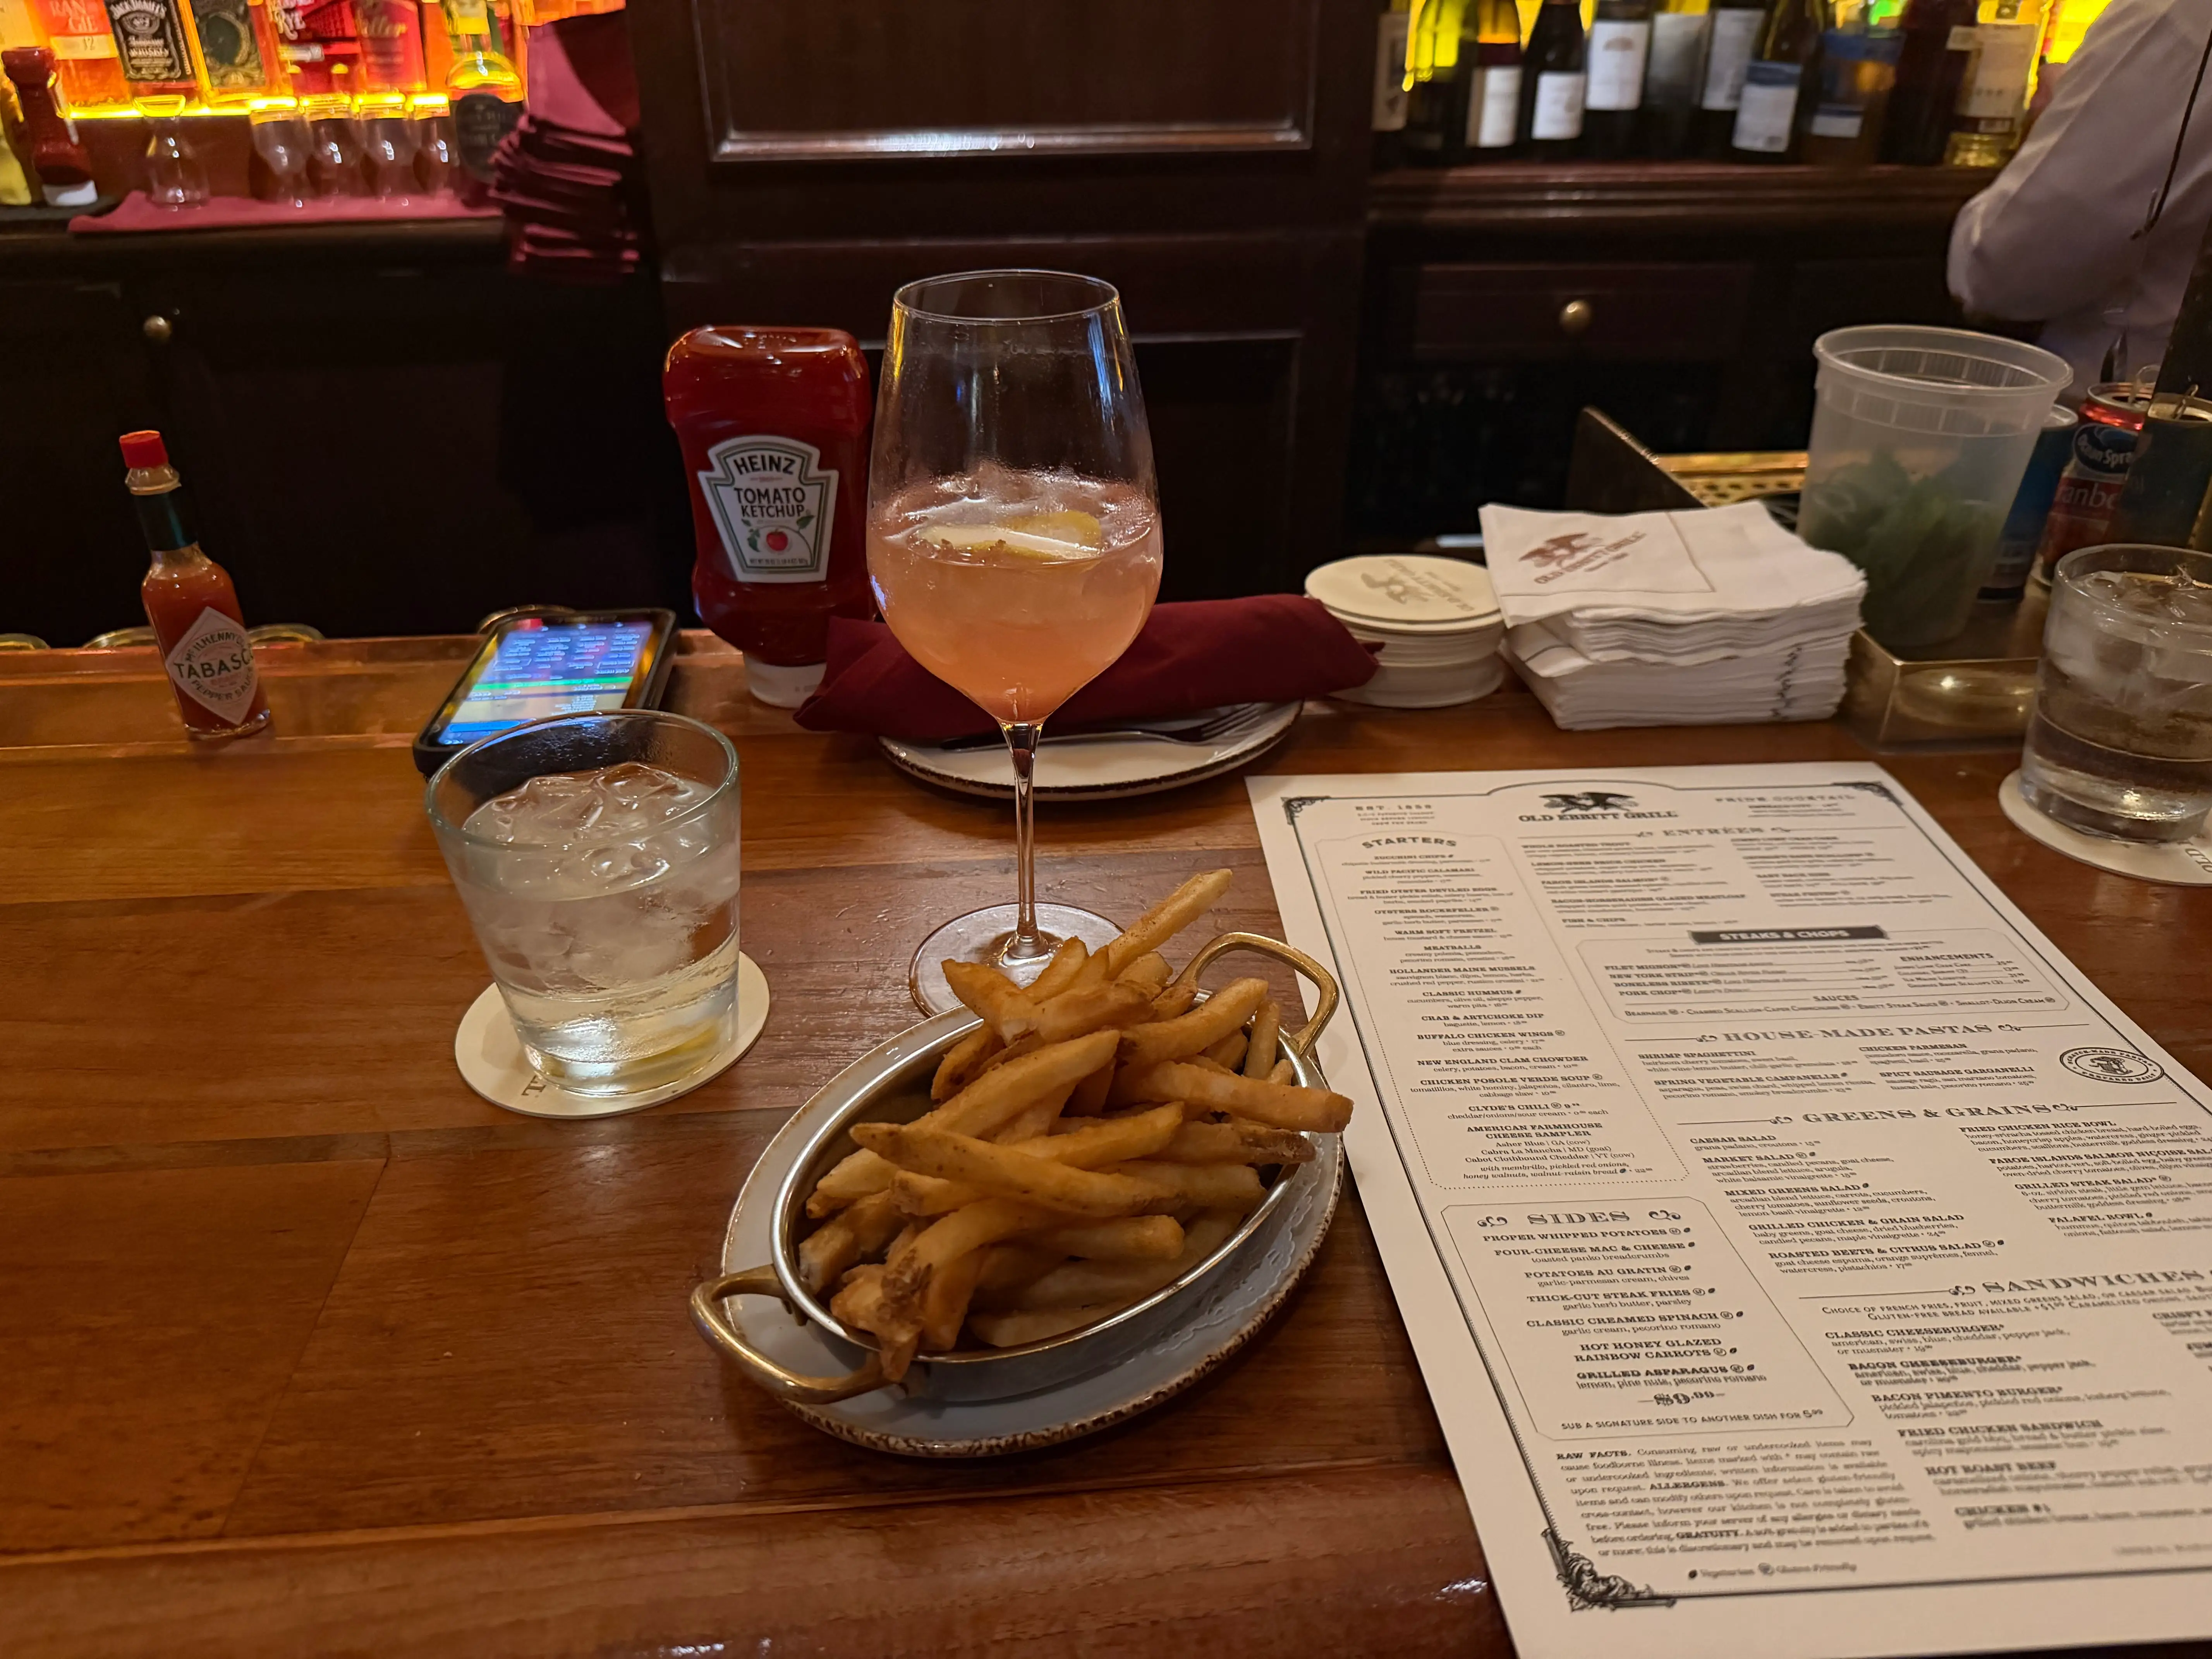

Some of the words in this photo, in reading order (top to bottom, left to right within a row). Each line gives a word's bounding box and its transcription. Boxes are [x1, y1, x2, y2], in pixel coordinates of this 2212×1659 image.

[733, 454, 796, 475] HEINZ
[733, 487, 805, 504] TOMATO
[741, 504, 805, 518] KETCHUP
[191, 680, 233, 700] PEPPER
[1362, 836, 1457, 849] STARTERS
[1720, 932, 1781, 941] STEAKS
[1796, 929, 1850, 939] CHOPS
[1899, 953, 1994, 962] ENHANCEMENTS
[1722, 1028, 1894, 1041] HOUSE-MADE
[1896, 1025, 1992, 1036] PASTAS
[1803, 1110, 1916, 1122] GREENS
[1946, 1104, 2051, 1117] GRAINS
[1527, 1211, 1630, 1224] SIDES
[1807, 1219, 1865, 1228] CHICKEN
[1494, 1247, 1587, 1255] FOUR-CHEESE
[1982, 1270, 2205, 1292] SANDWICHES
[1527, 1293, 1599, 1302] THICK-CUT
[1527, 1319, 1584, 1327] CLASSIC
[1587, 1316, 1656, 1324] CREAMED
[1659, 1313, 1719, 1321] SPINACH
[1826, 1330, 1884, 1338] CLASSIC
[1612, 1341, 1662, 1349] HONEY
[1666, 1339, 1721, 1347] GLAZED
[1574, 1352, 1640, 1362] RAINBOW
[1645, 1349, 1711, 1358] CARROTS
[1577, 1370, 1641, 1379] GRILLED
[1645, 1366, 1728, 1376] ASPARAGUS
[1595, 1419, 1654, 1428] SIGNATURE
